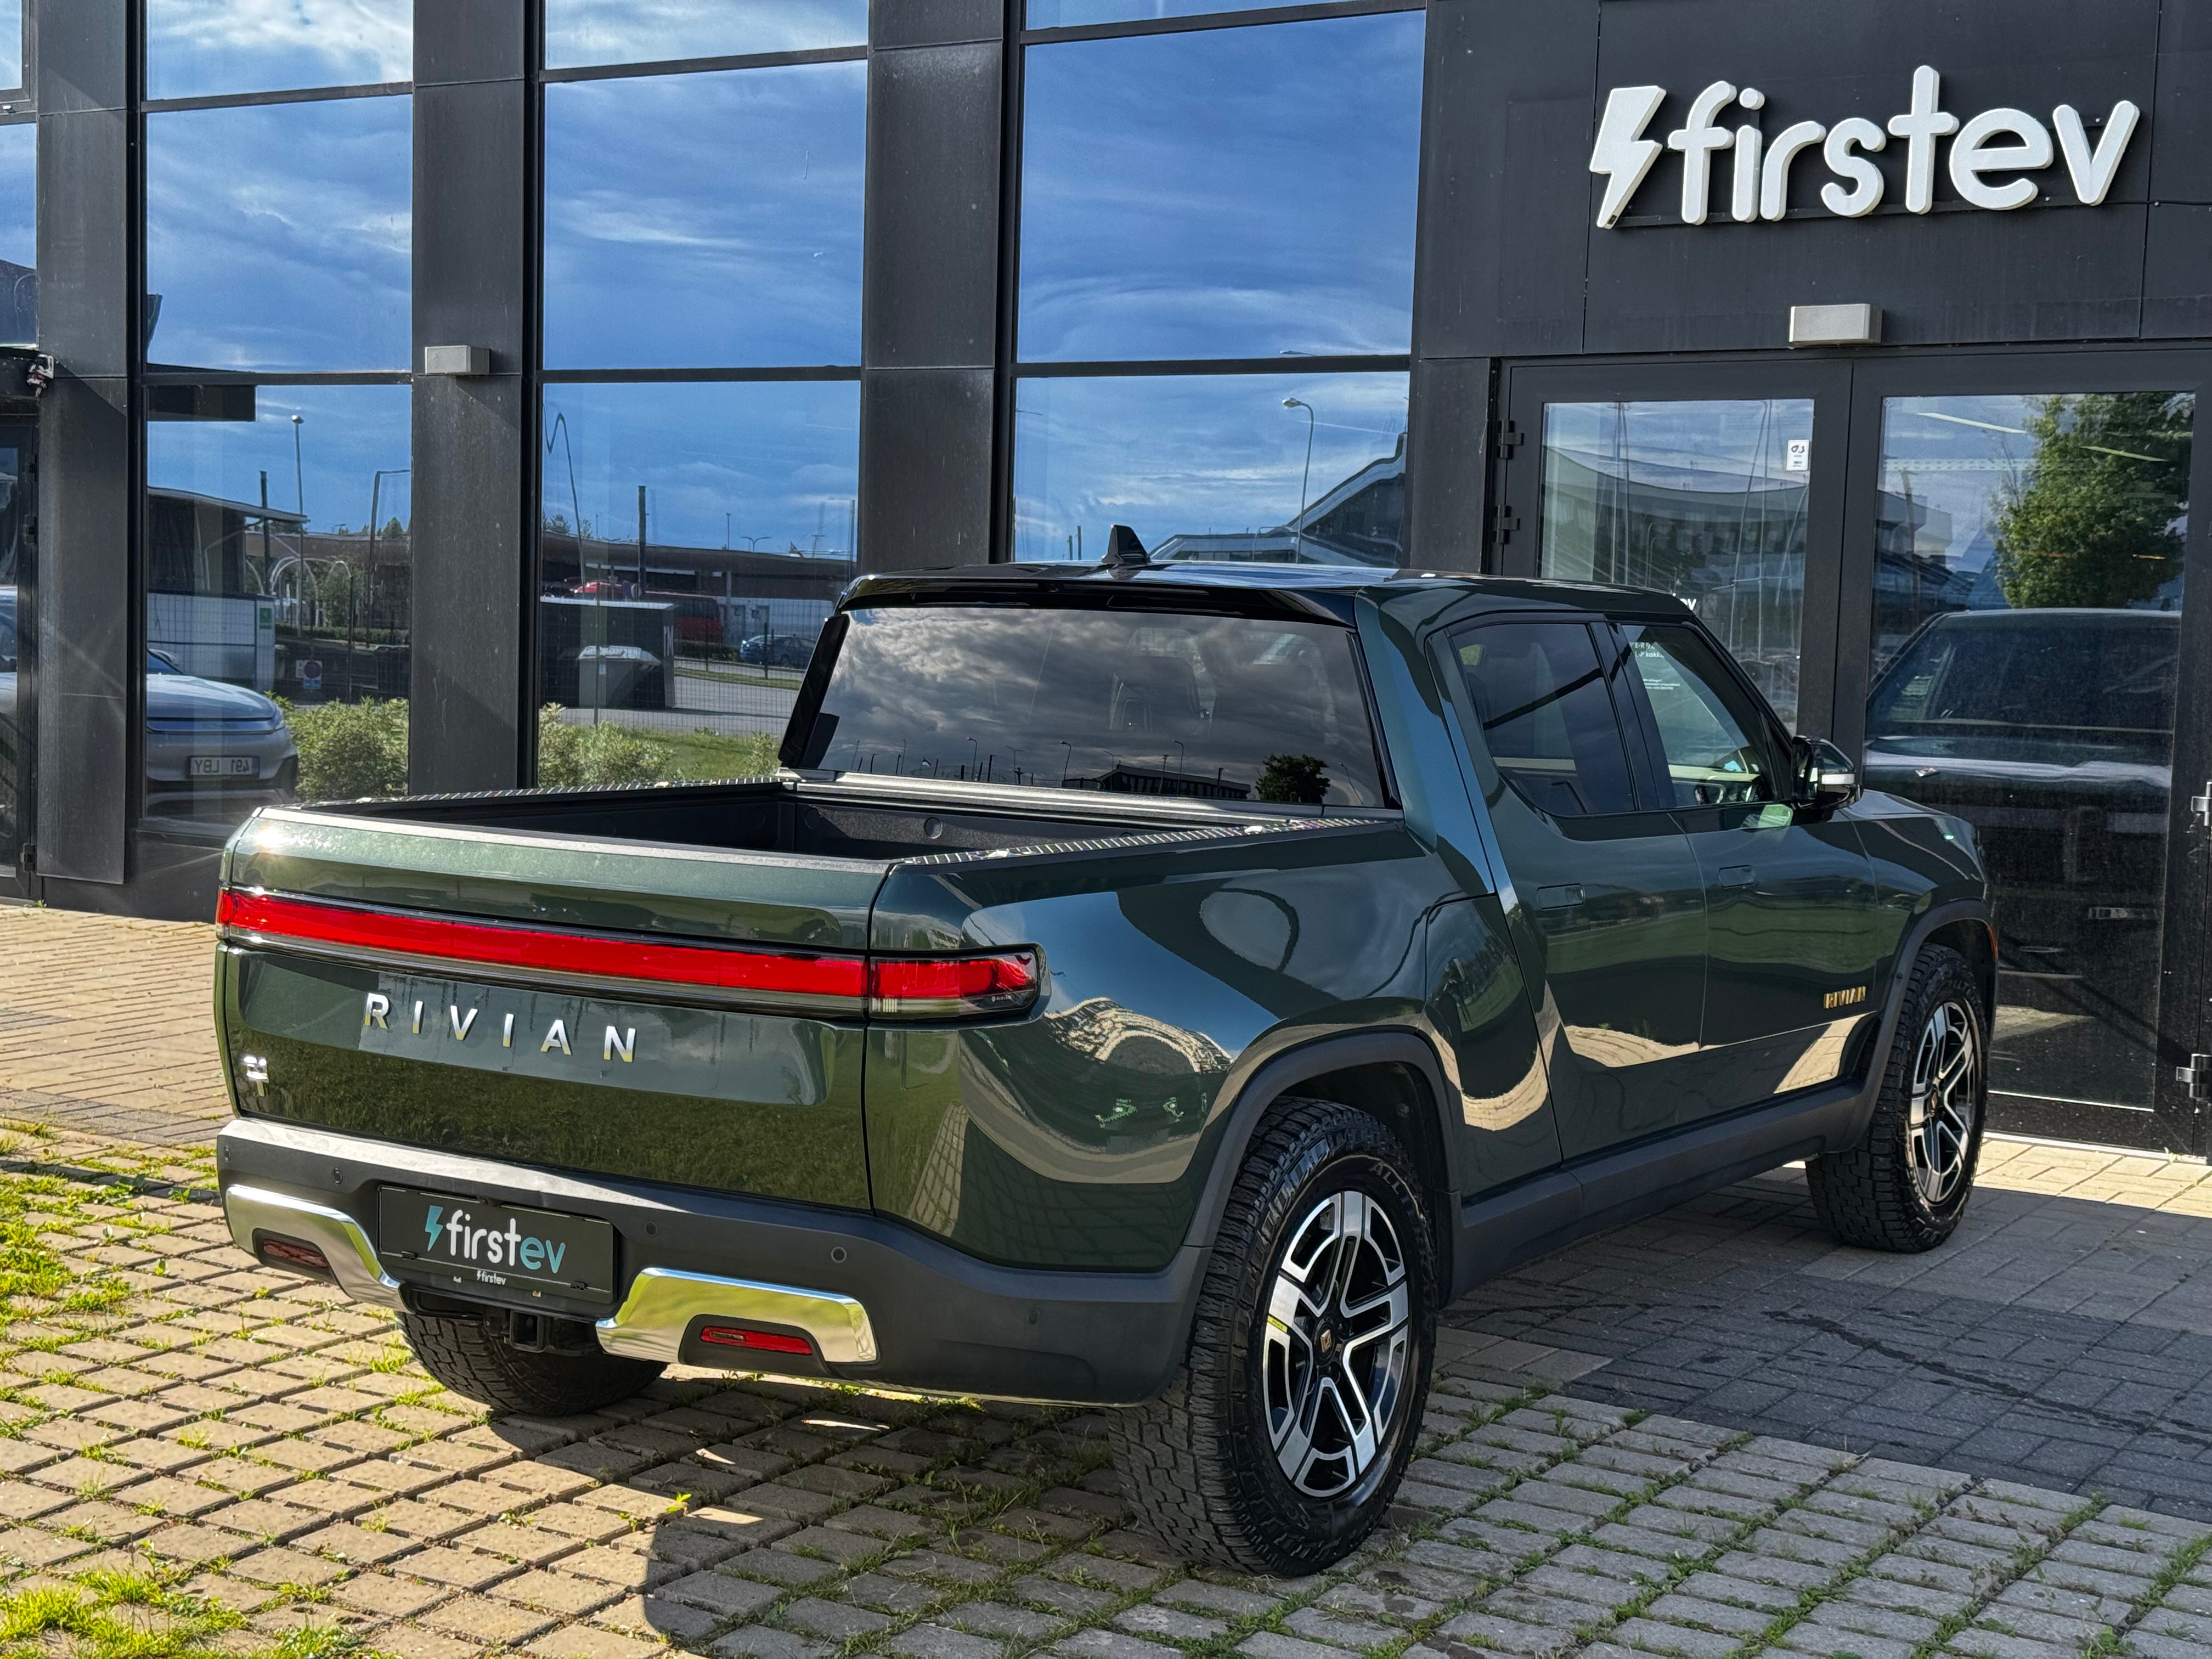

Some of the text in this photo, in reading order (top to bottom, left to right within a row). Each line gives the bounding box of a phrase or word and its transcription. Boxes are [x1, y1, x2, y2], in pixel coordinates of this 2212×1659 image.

[1667, 64, 2139, 227] firstev
[364, 992, 636, 1063] RIVIAN
[1824, 986, 1866, 1009] RIVIAN
[446, 1209, 566, 1274] firstev
[481, 1271, 506, 1286] firstev
